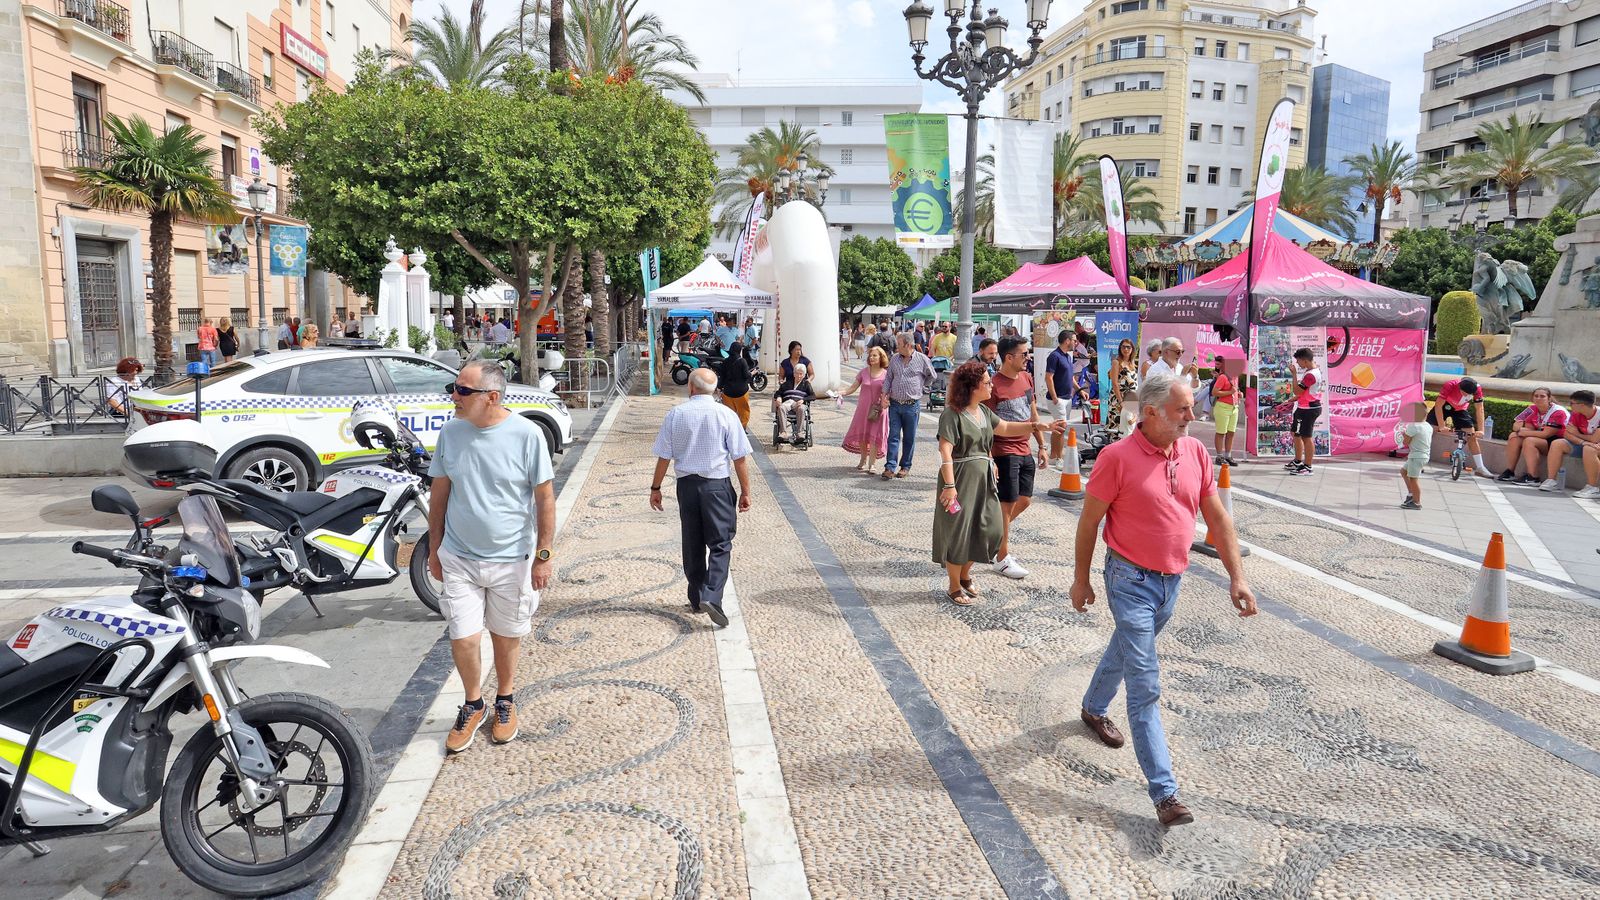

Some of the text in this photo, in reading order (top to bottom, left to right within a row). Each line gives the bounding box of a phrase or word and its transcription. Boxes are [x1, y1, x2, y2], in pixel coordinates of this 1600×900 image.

[695, 281, 741, 290] YAMAHA
[1164, 299, 1198, 308] MOUNTAIN
[1199, 301, 1219, 309] BIKE
[1310, 300, 1365, 309] MOUNTAIN
[1368, 302, 1392, 310] BIKE
[1355, 344, 1384, 357] JEREZ
[1371, 400, 1402, 419] JEREZ
[233, 414, 256, 422] 092
[323, 453, 336, 461] 112
[325, 481, 336, 489] 112
[353, 478, 392, 491] POLICIA LOCAL
[18, 627, 36, 641] 112
[62, 625, 94, 644] POLICIA
